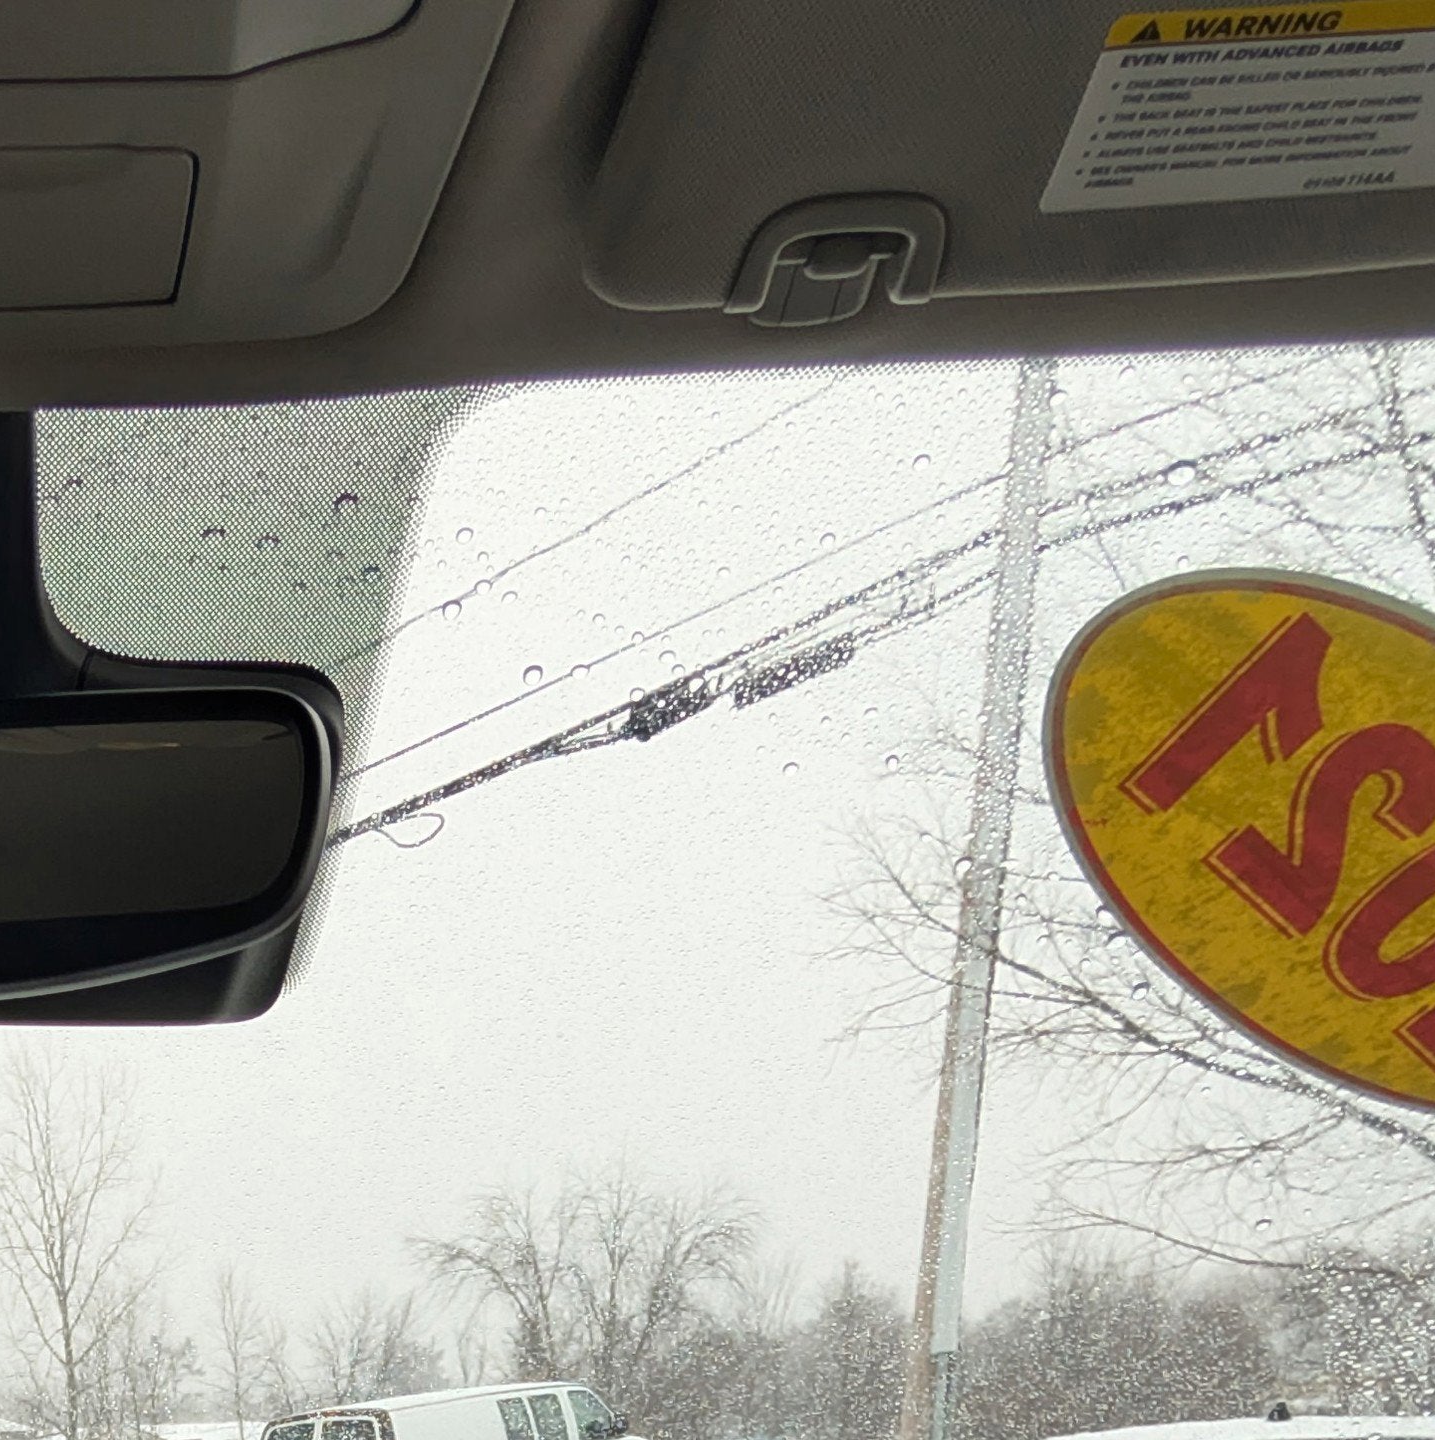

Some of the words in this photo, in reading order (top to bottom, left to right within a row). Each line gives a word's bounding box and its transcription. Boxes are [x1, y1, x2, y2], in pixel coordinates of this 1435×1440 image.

[1183, 11, 1342, 40] WARNING
[1120, 53, 1170, 68] EVEN
[1173, 50, 1219, 66] WITH
[1221, 44, 1318, 63] ADVANCED
[1324, 39, 1404, 56] AIRBAGS
